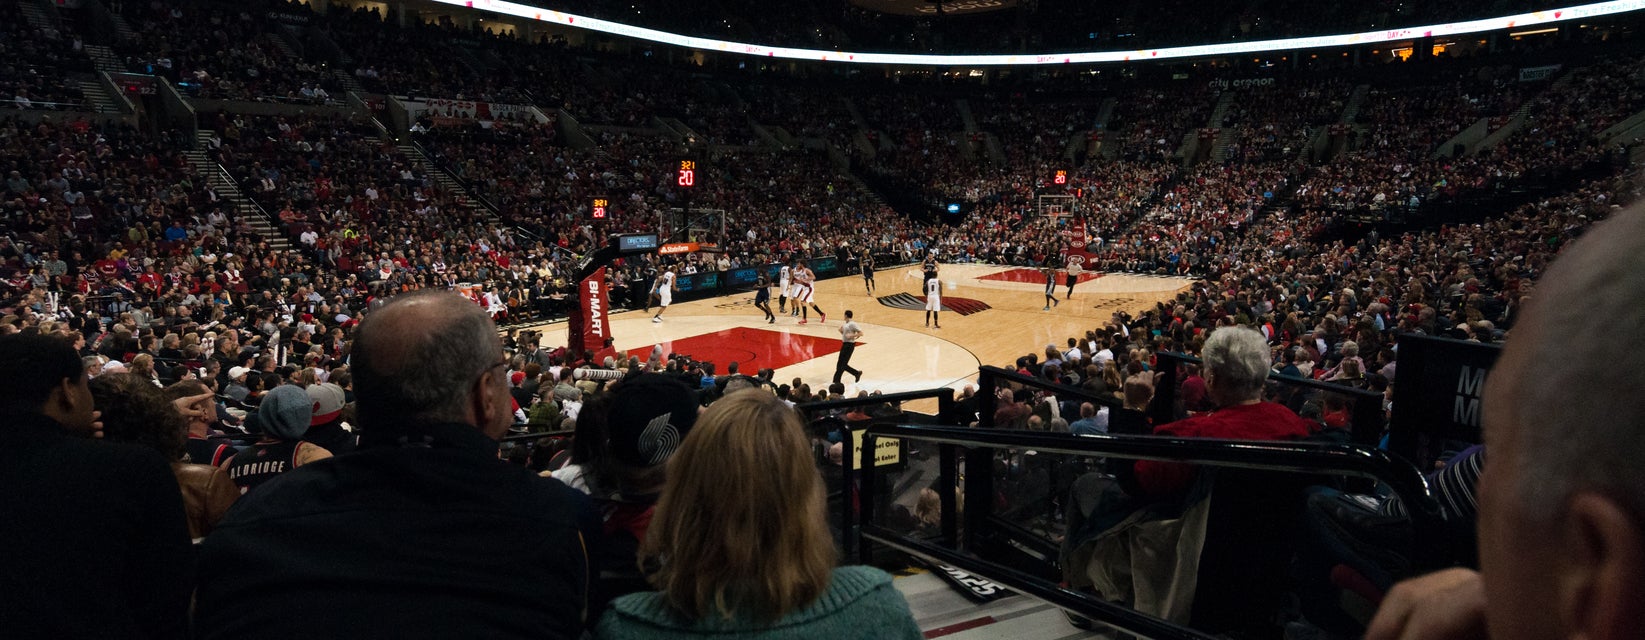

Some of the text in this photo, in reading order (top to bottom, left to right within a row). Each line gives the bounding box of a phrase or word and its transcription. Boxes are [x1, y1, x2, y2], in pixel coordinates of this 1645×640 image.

[679, 170, 693, 186] 20
[1054, 175, 1066, 184] 20
[593, 207, 604, 218] 20
[885, 440, 899, 448] Only
[230, 460, 286, 480] ALDRIDGE
